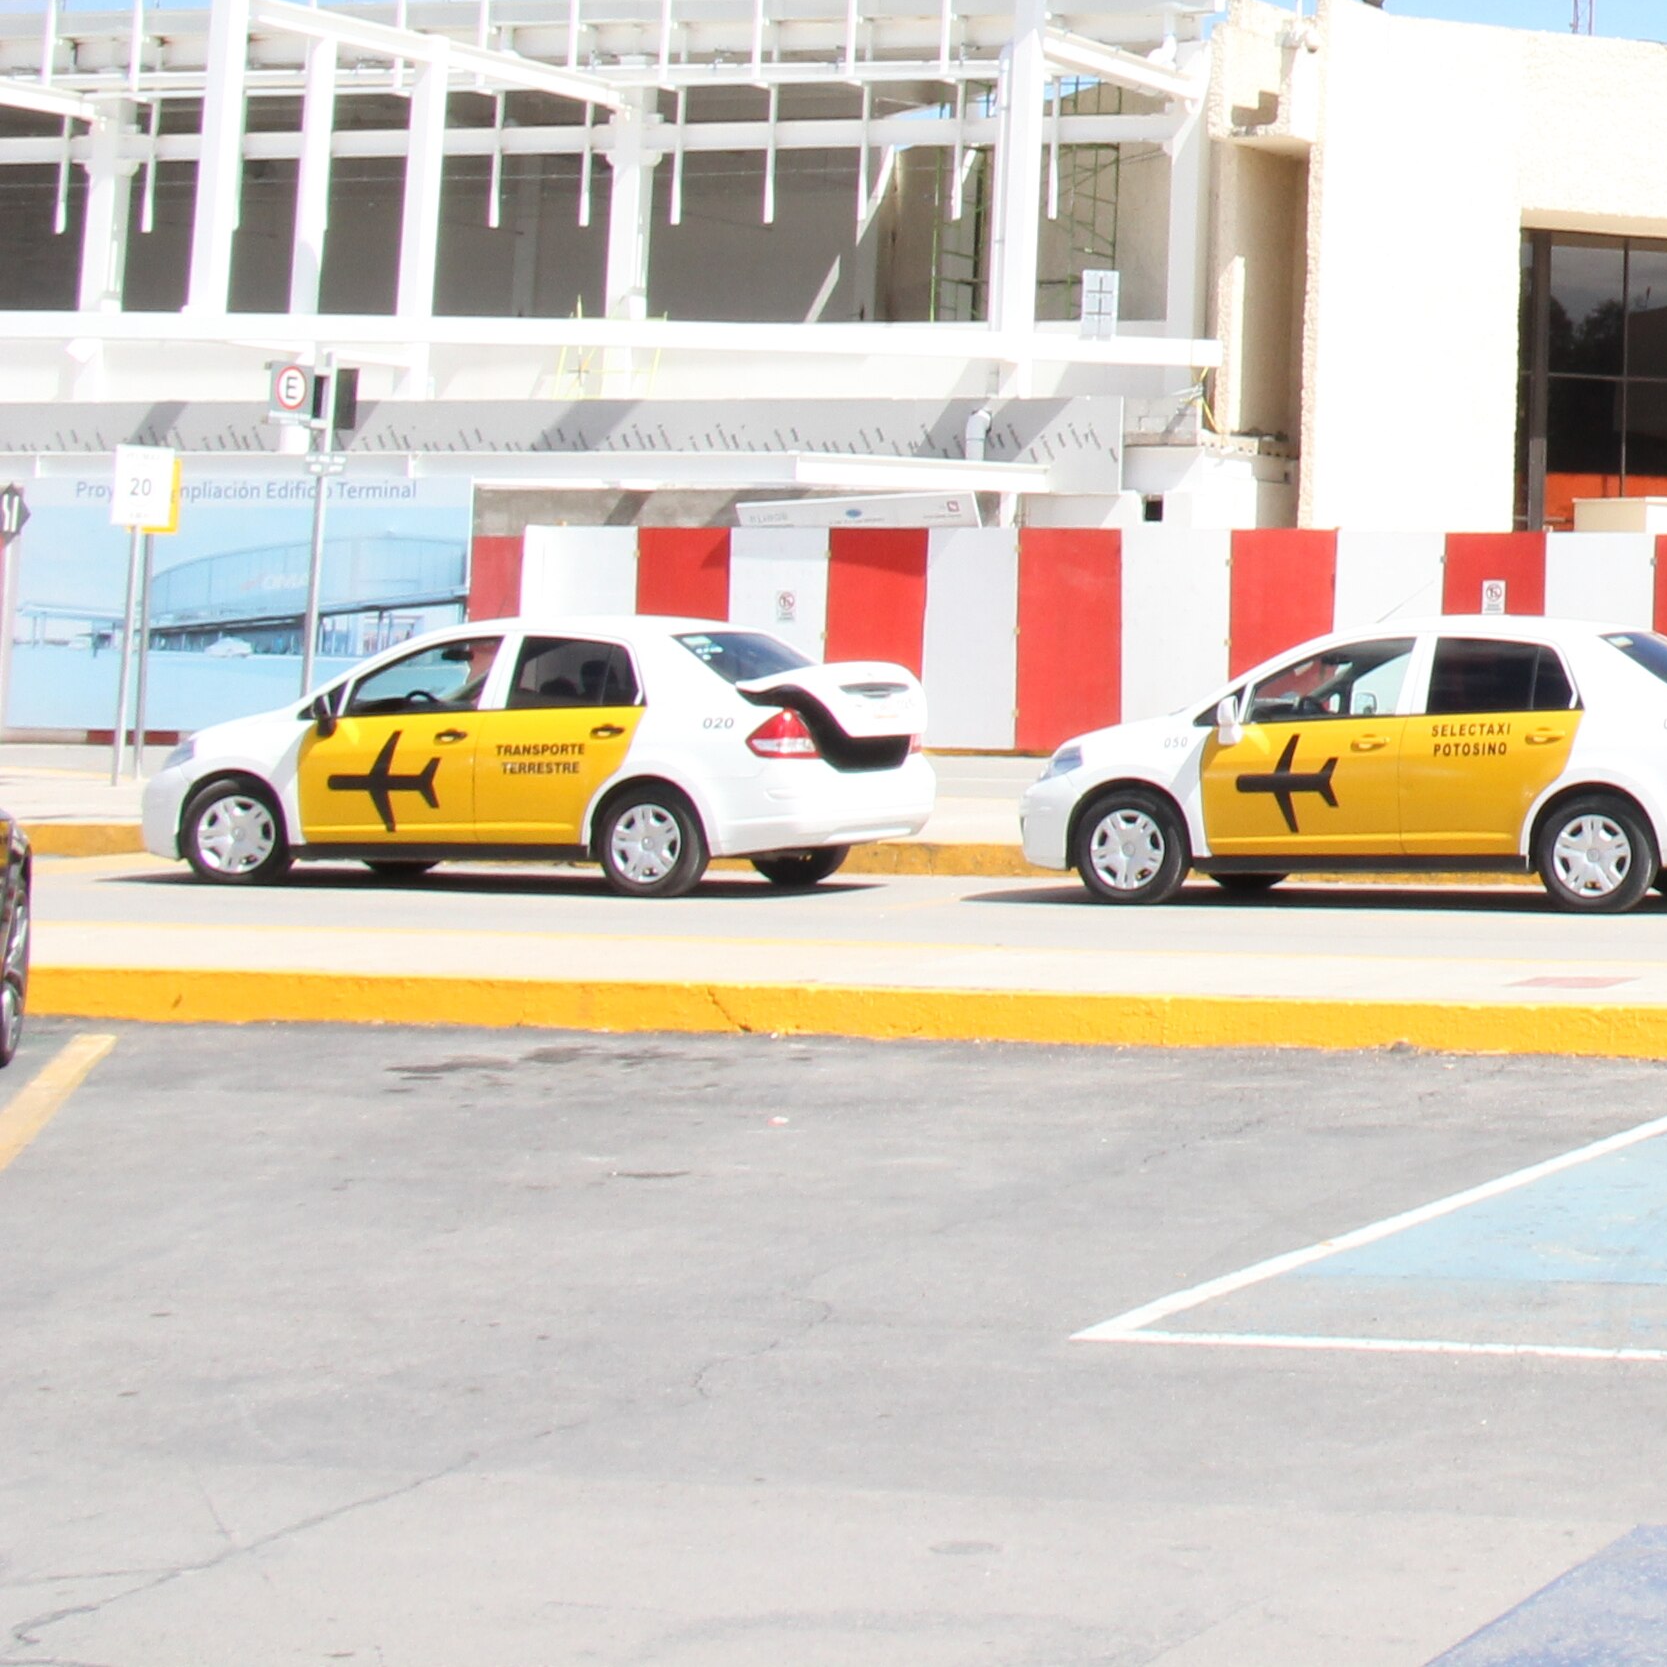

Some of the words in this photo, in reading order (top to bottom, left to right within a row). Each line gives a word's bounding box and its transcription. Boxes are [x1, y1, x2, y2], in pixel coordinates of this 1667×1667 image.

[285, 375, 298, 400] E
[129, 477, 152, 496] 20
[336, 479, 417, 500] Terminal
[702, 717, 735, 730] 020
[1431, 722, 1512, 738] SELECTAXI
[495, 743, 585, 757] TRANSPORTE
[1164, 736, 1188, 749] 050
[1433, 741, 1508, 757] POTOSINO
[501, 761, 580, 775] TERRESTRE
